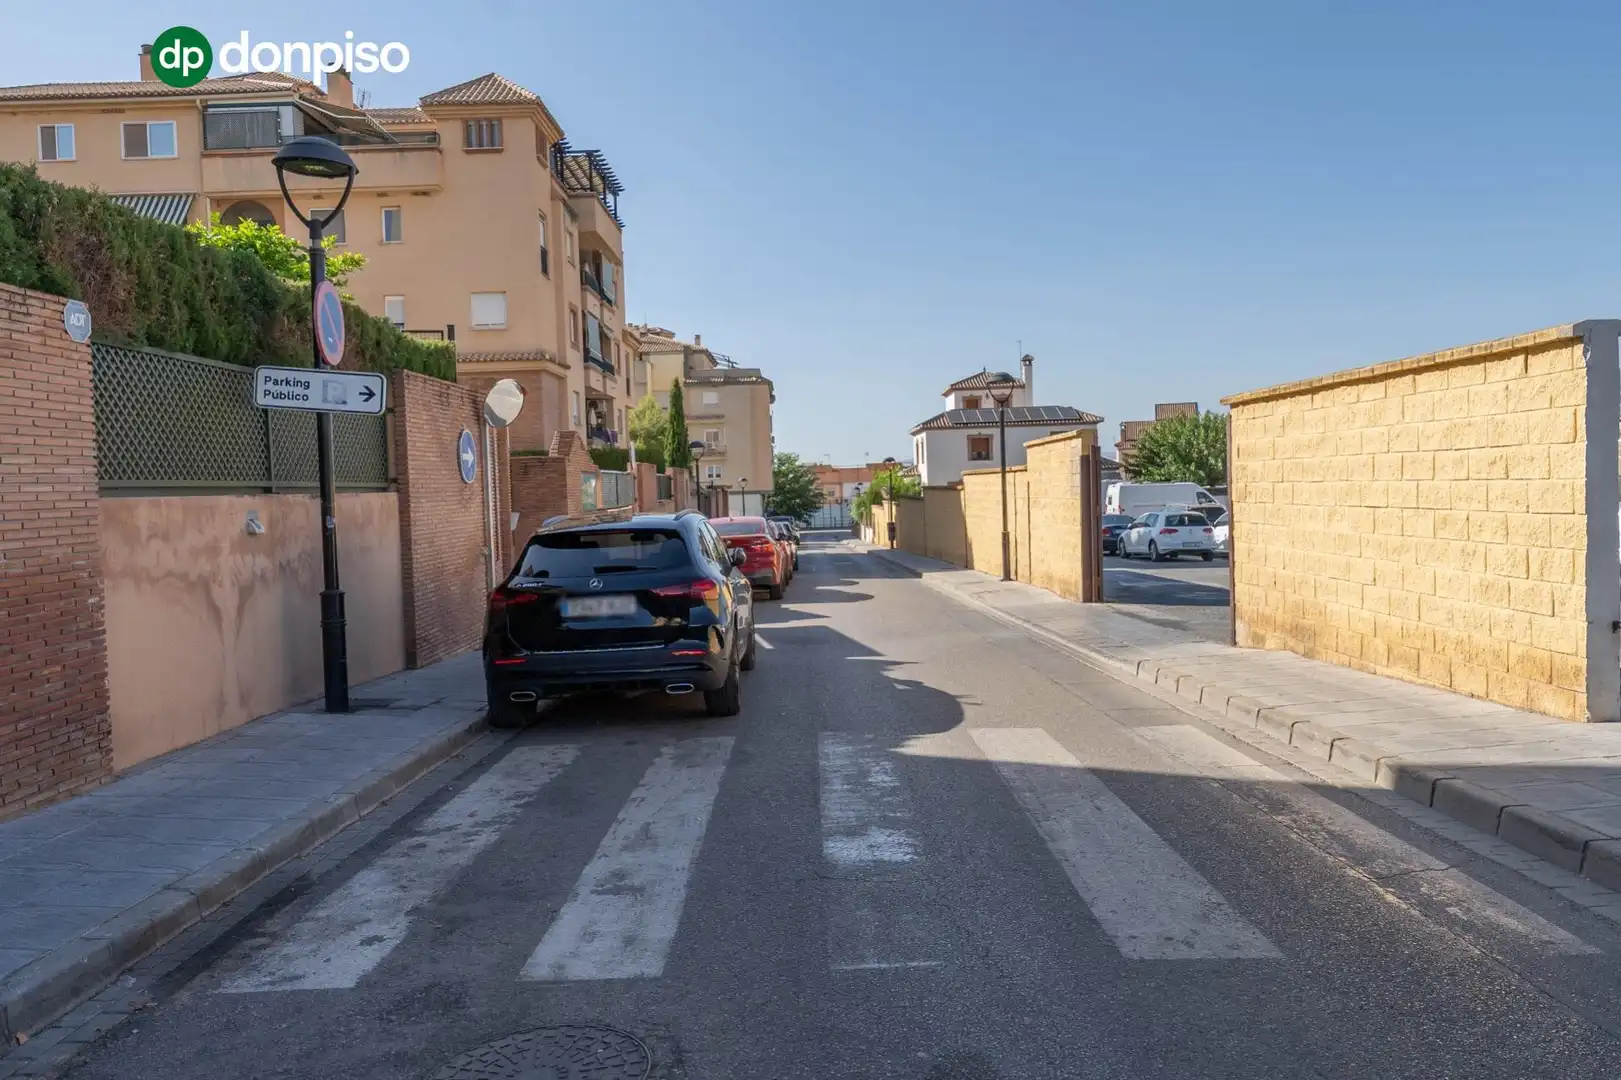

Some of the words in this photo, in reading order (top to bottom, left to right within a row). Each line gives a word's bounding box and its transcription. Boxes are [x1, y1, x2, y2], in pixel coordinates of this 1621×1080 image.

[70, 313, 86, 327] ADT
[264, 375, 310, 390] Parking
[263, 389, 309, 402] Público
